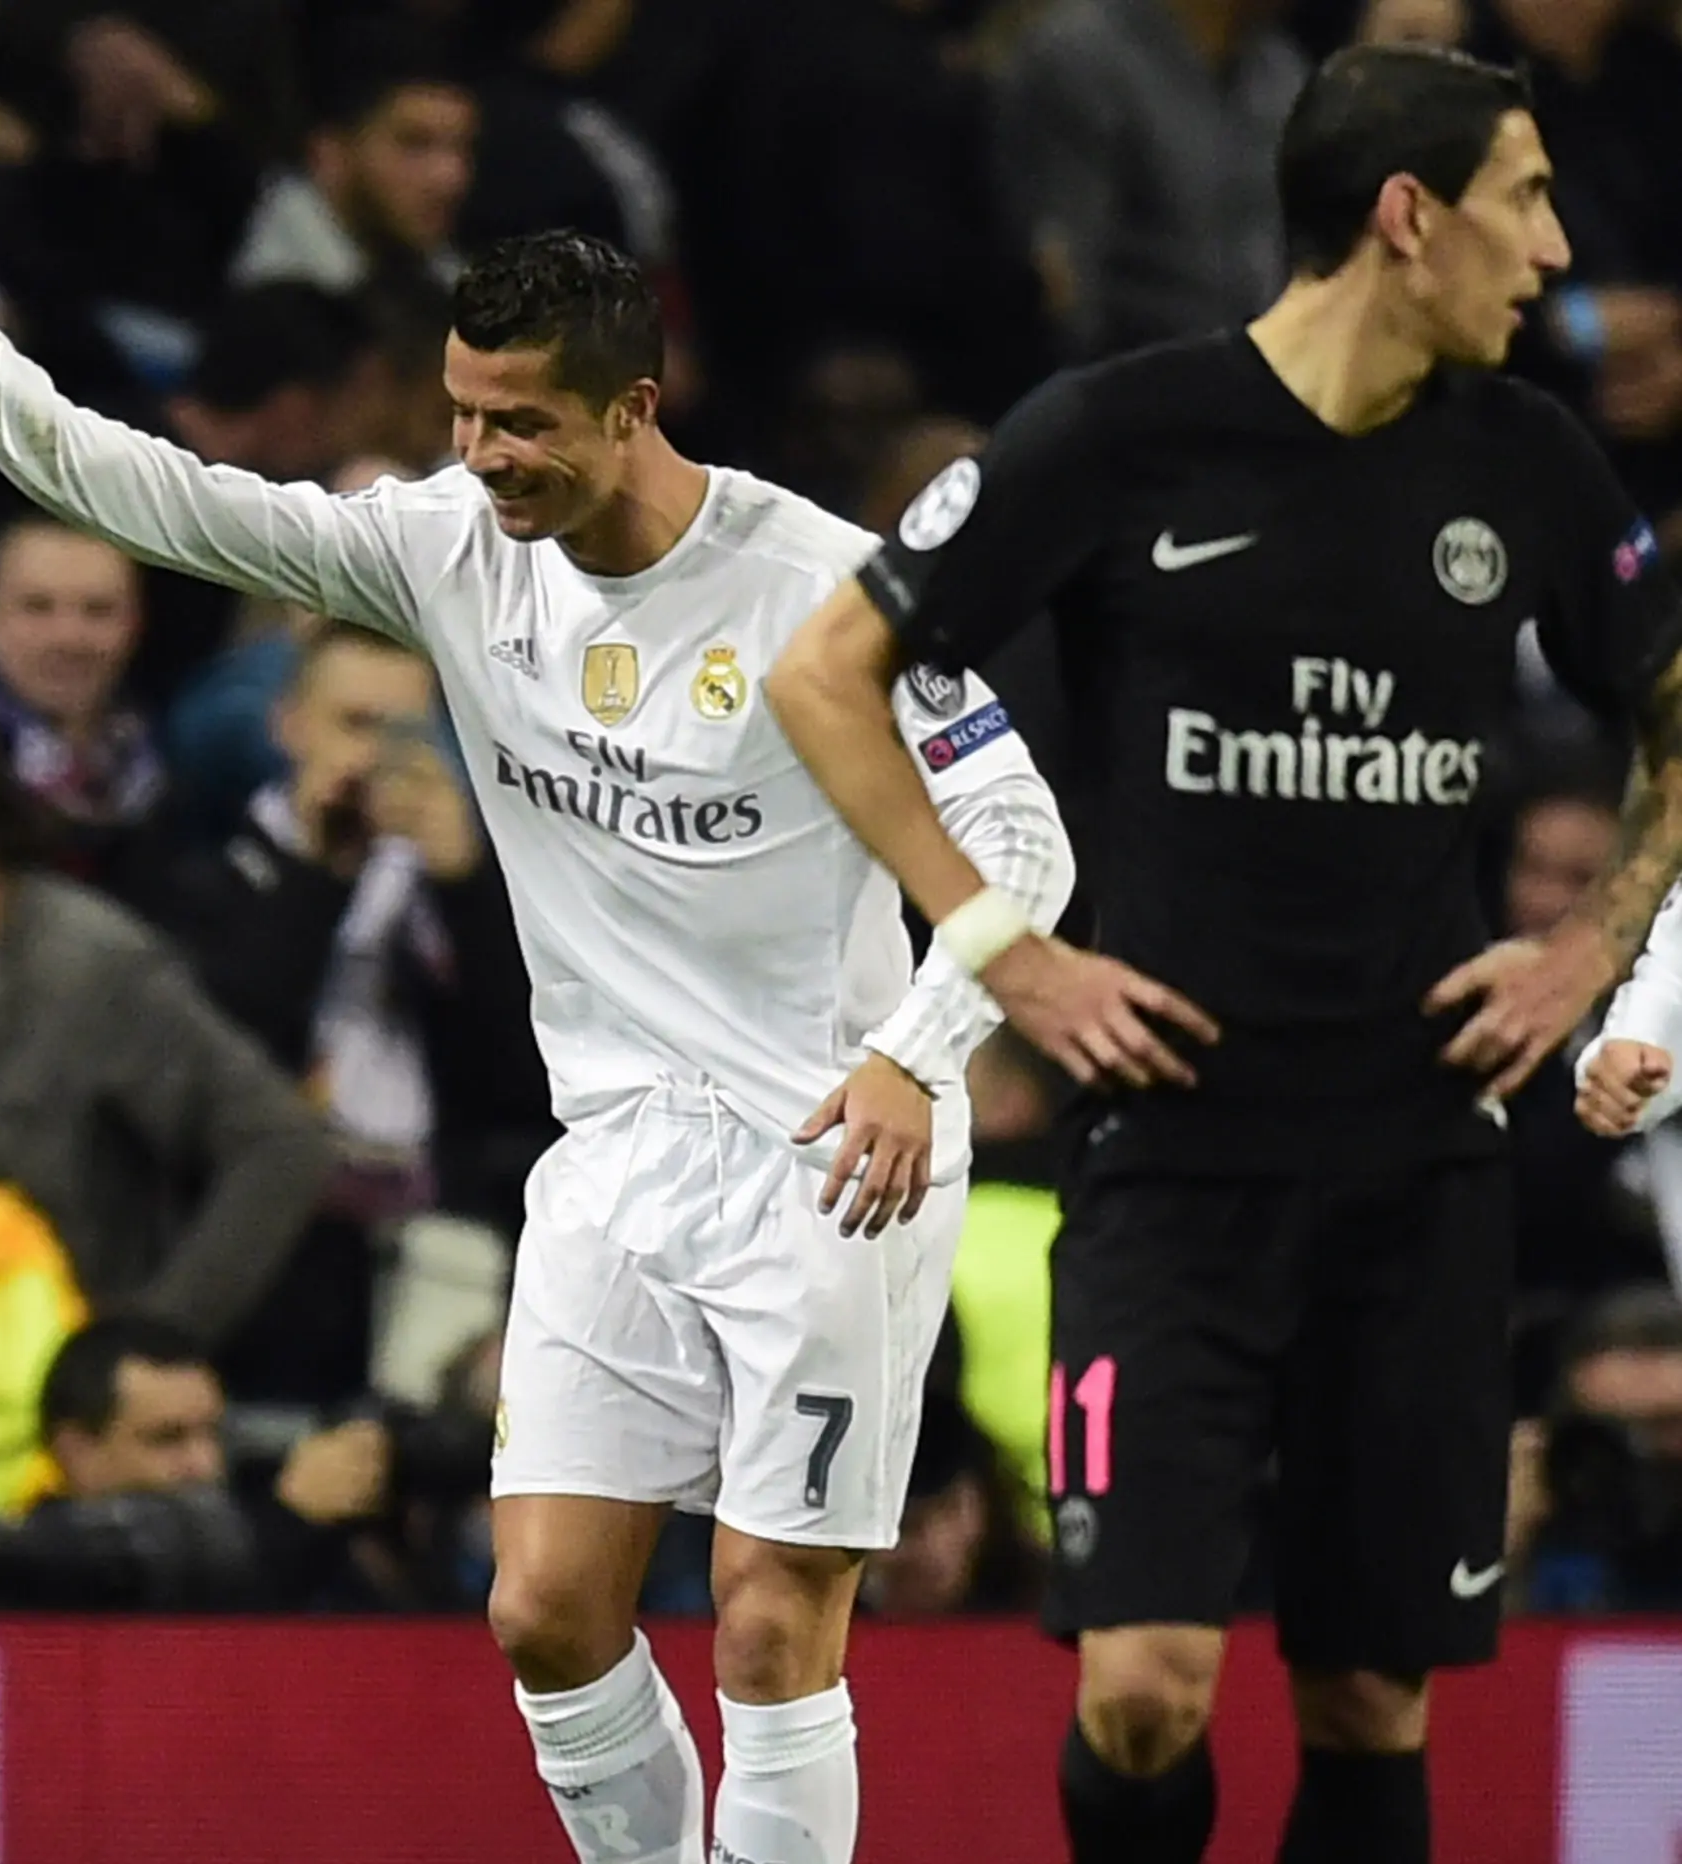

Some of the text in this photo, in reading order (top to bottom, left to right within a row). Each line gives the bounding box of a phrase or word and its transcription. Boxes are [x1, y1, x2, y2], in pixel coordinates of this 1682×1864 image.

[1291, 655, 1394, 728] Fly
[493, 740, 762, 845] Emirates
[566, 729, 645, 782] Fly
[1166, 707, 1483, 805] Emirates
[796, 1393, 853, 1509] 7
